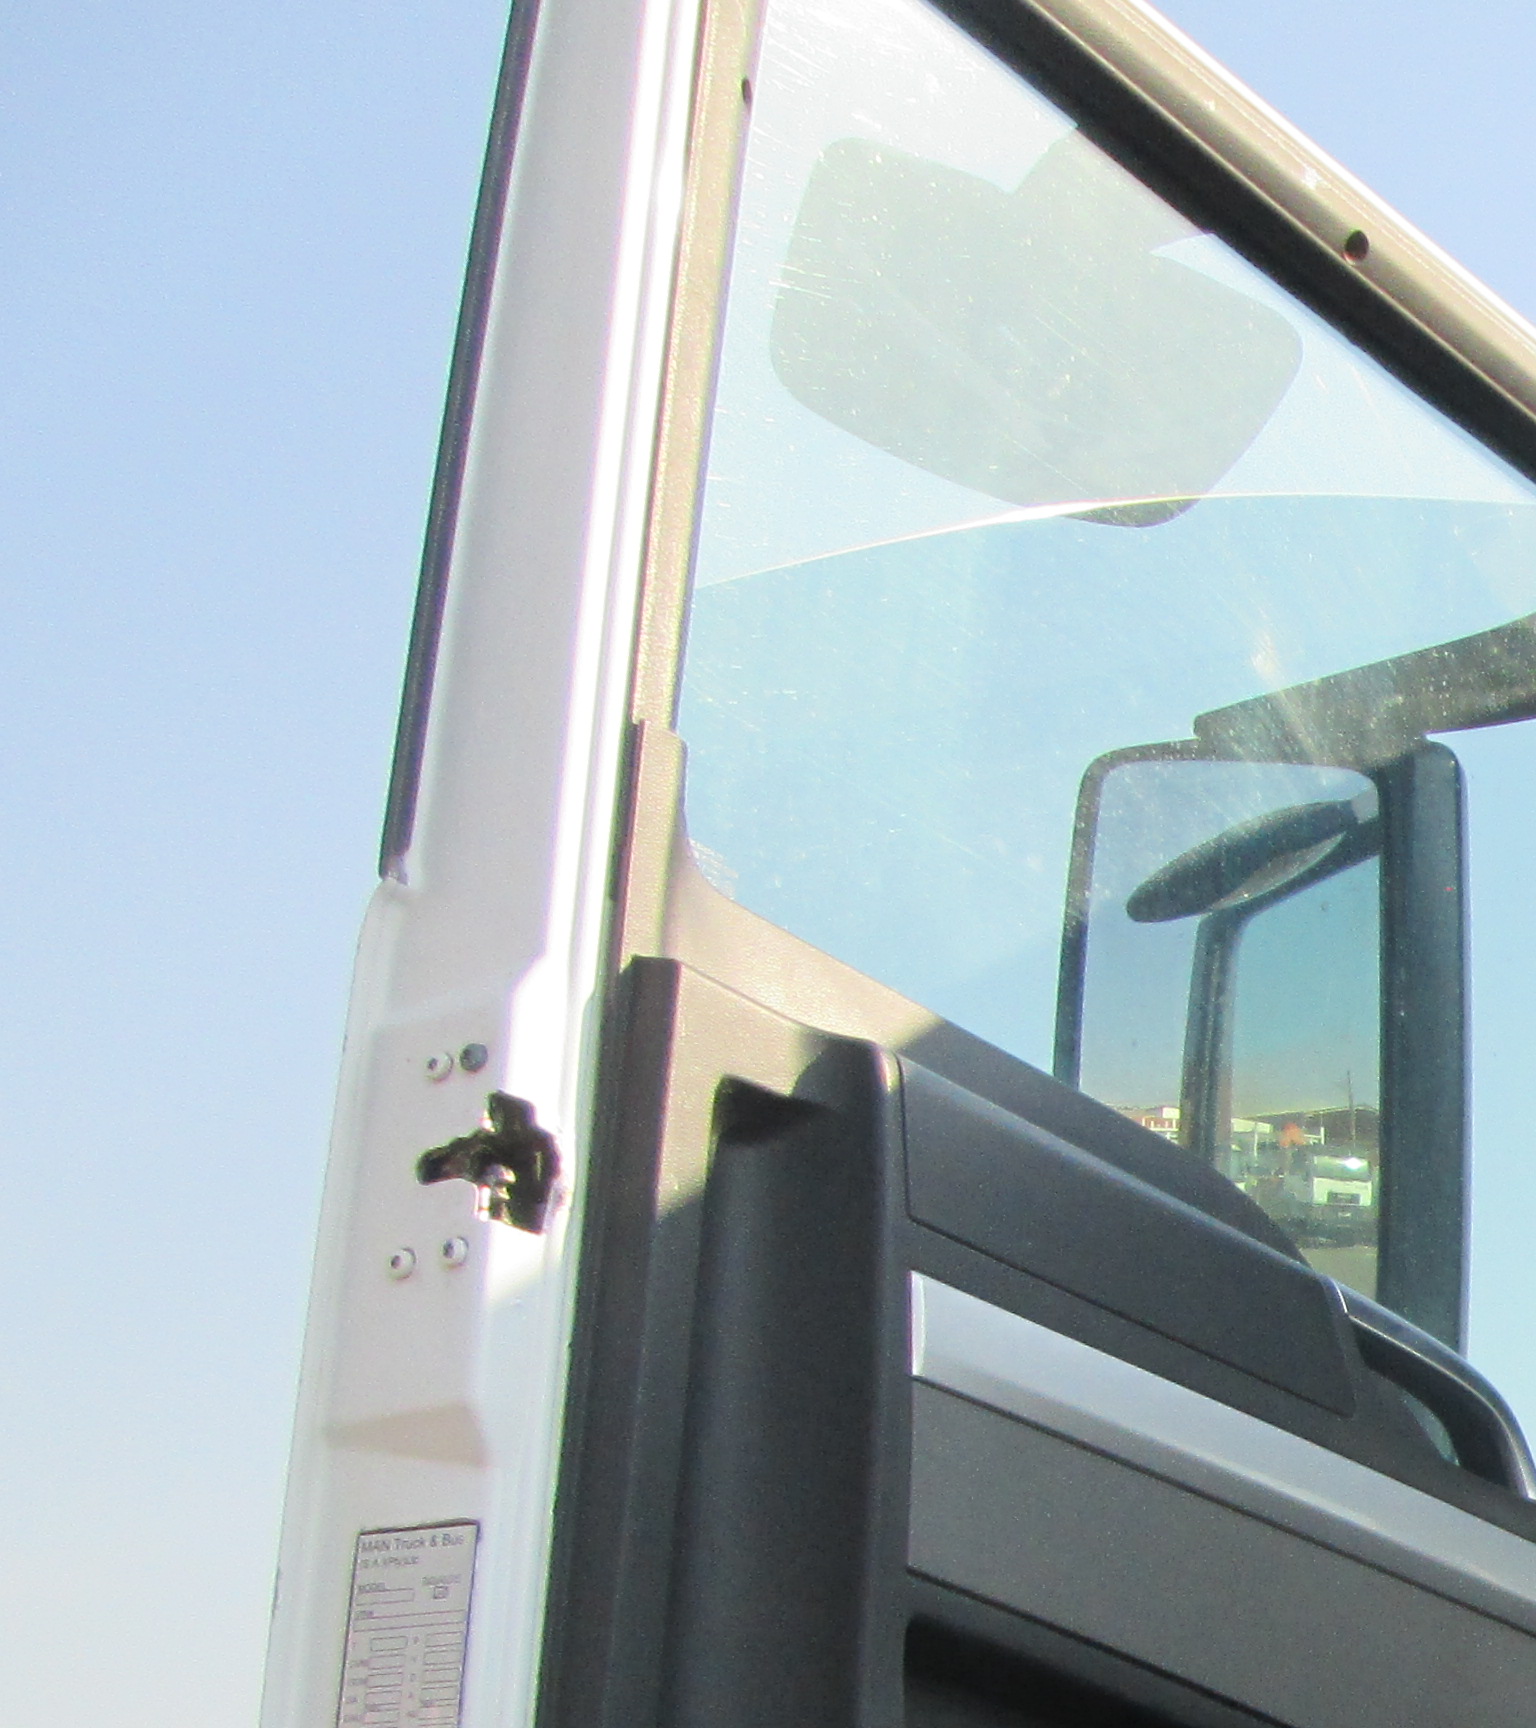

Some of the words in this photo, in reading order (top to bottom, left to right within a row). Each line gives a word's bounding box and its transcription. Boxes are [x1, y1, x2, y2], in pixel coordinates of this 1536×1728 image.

[361, 1540, 391, 1553] MAN
[393, 1537, 425, 1550] Truck
[429, 1535, 438, 1548] &
[442, 1533, 465, 1547] Bus
